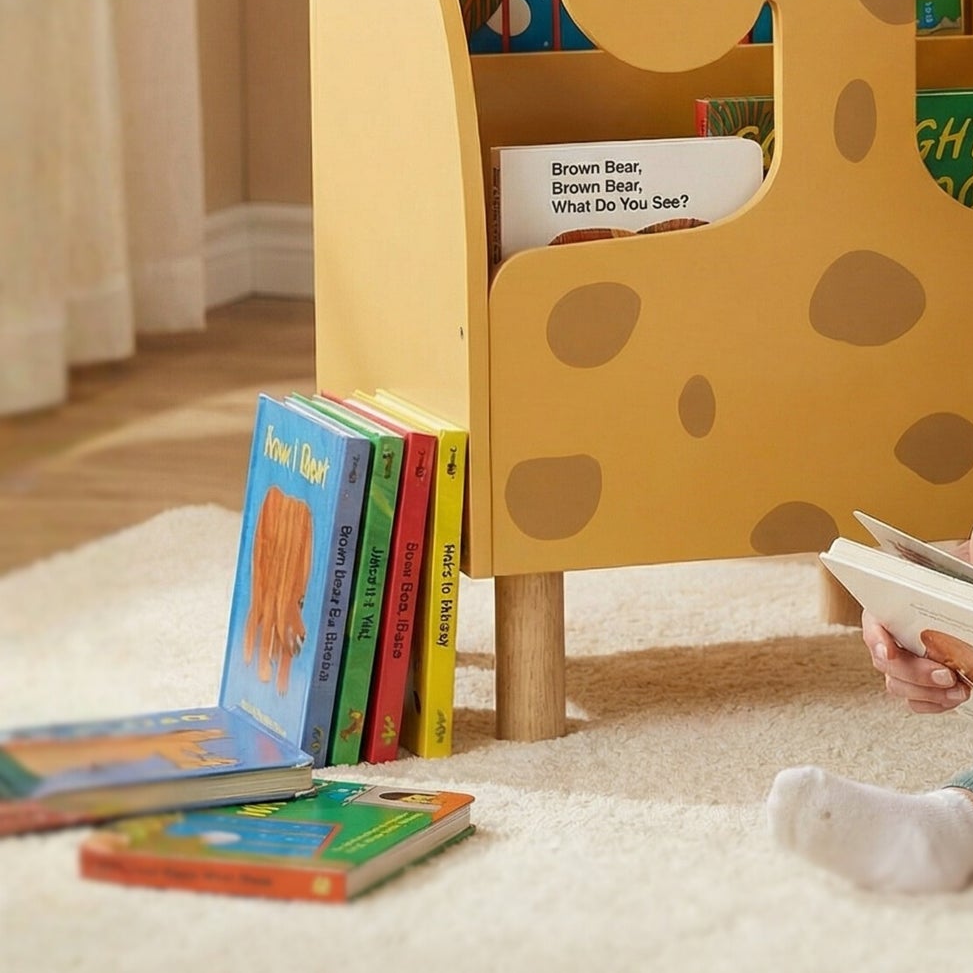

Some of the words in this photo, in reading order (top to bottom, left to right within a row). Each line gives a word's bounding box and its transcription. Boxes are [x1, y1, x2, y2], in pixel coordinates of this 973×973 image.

[552, 162, 600, 176] Brown
[604, 160, 643, 175] Bear,
[552, 181, 600, 195] Brown
[605, 179, 643, 194] Bear,
[552, 200, 591, 214] What
[595, 198, 616, 212] Do
[619, 197, 648, 211] You
[652, 194, 689, 209] See?
[335, 525, 353, 566] Brown
